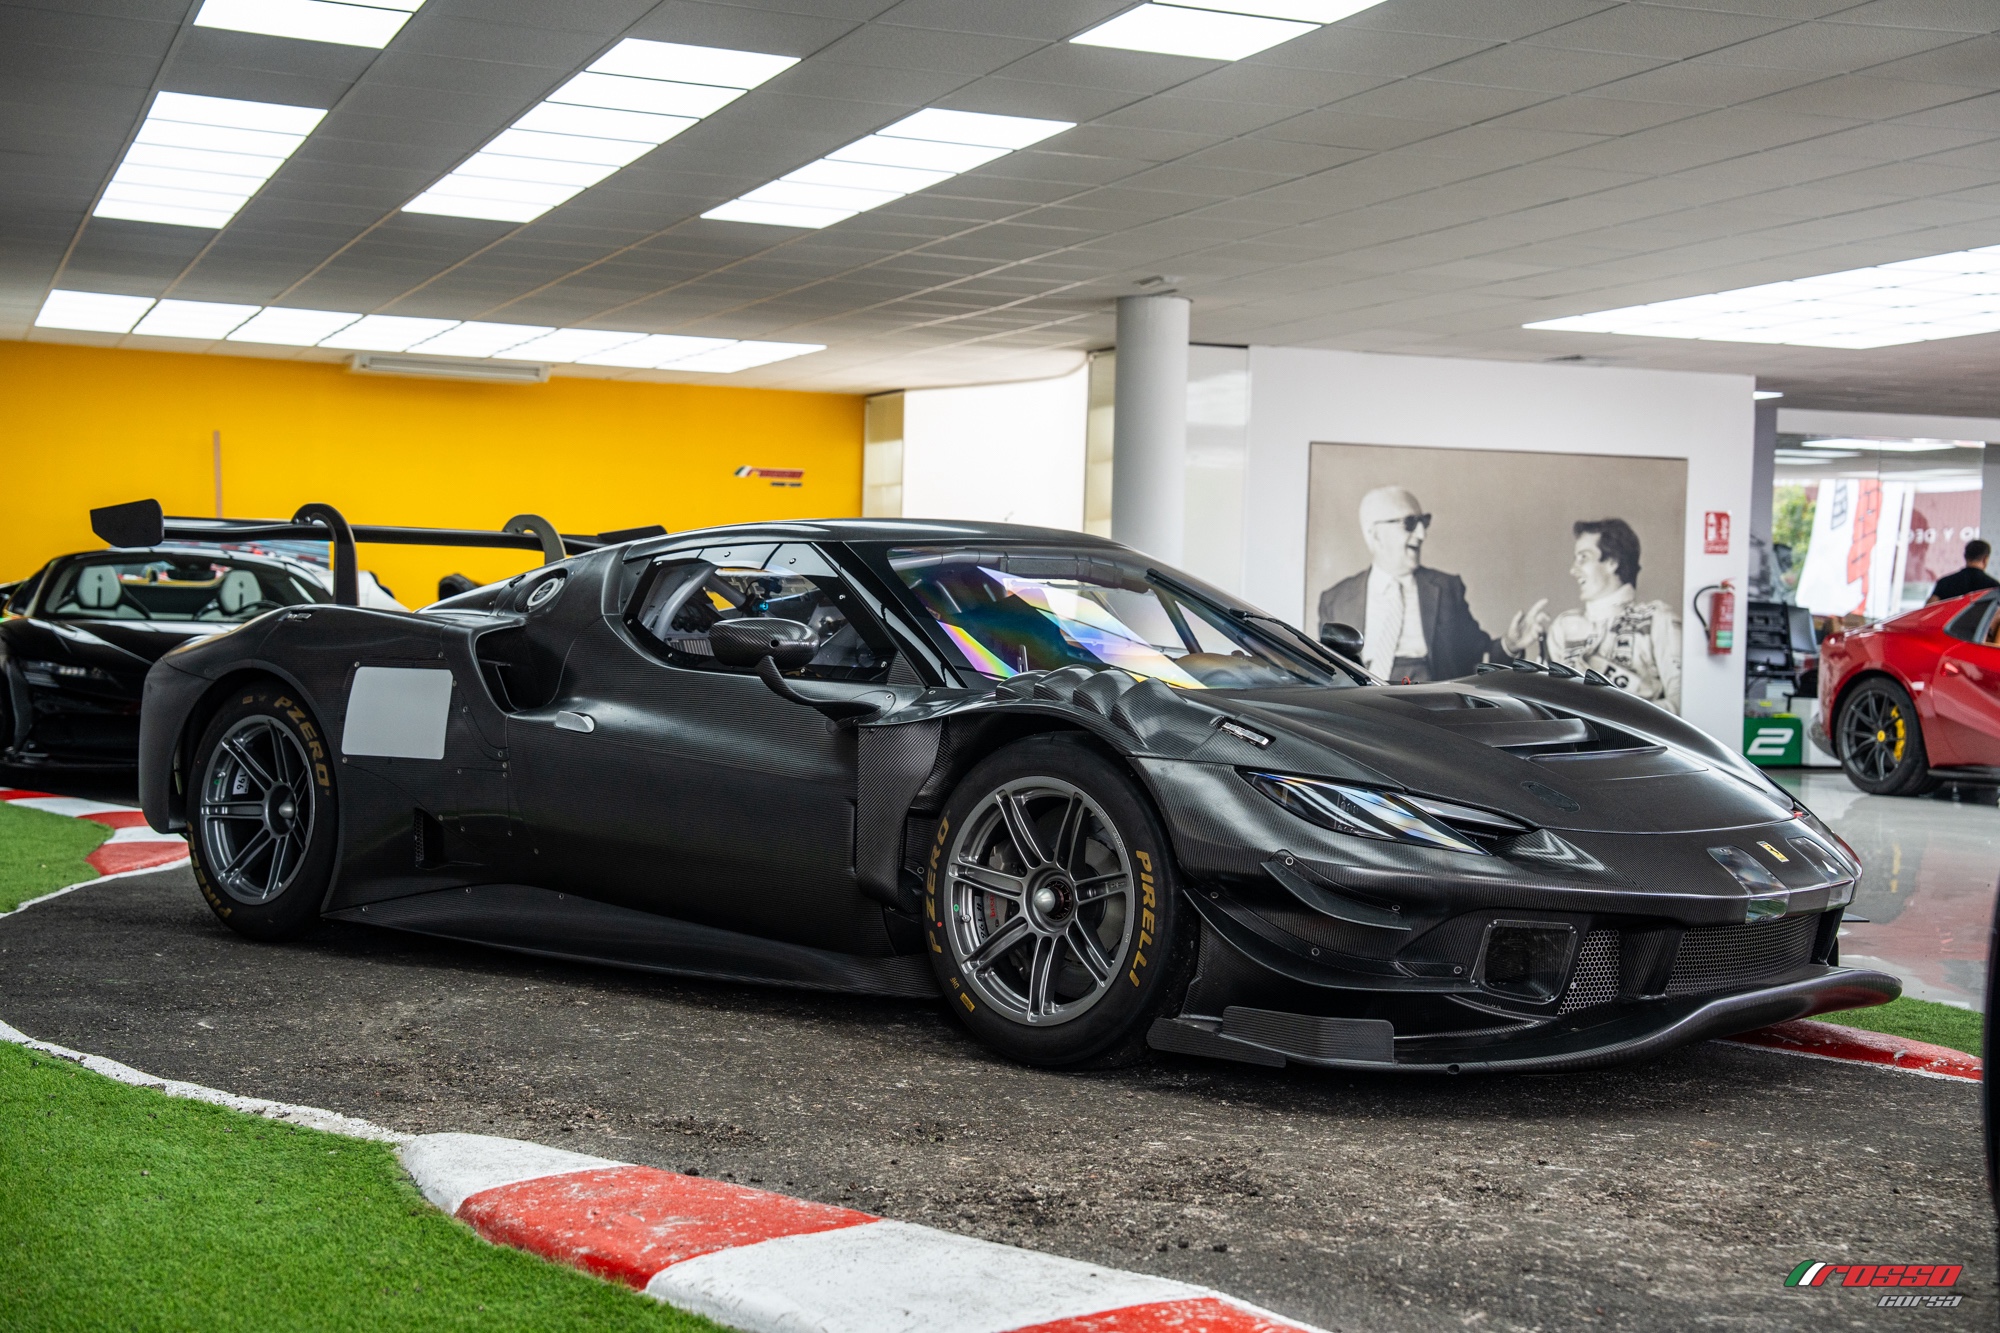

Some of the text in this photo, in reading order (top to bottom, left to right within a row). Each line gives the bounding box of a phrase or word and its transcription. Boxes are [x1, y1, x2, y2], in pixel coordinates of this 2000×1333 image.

[1746, 727, 1795, 757] 2
[926, 817, 949, 953] P ZERO
[1129, 850, 1156, 988] PIRELLI
